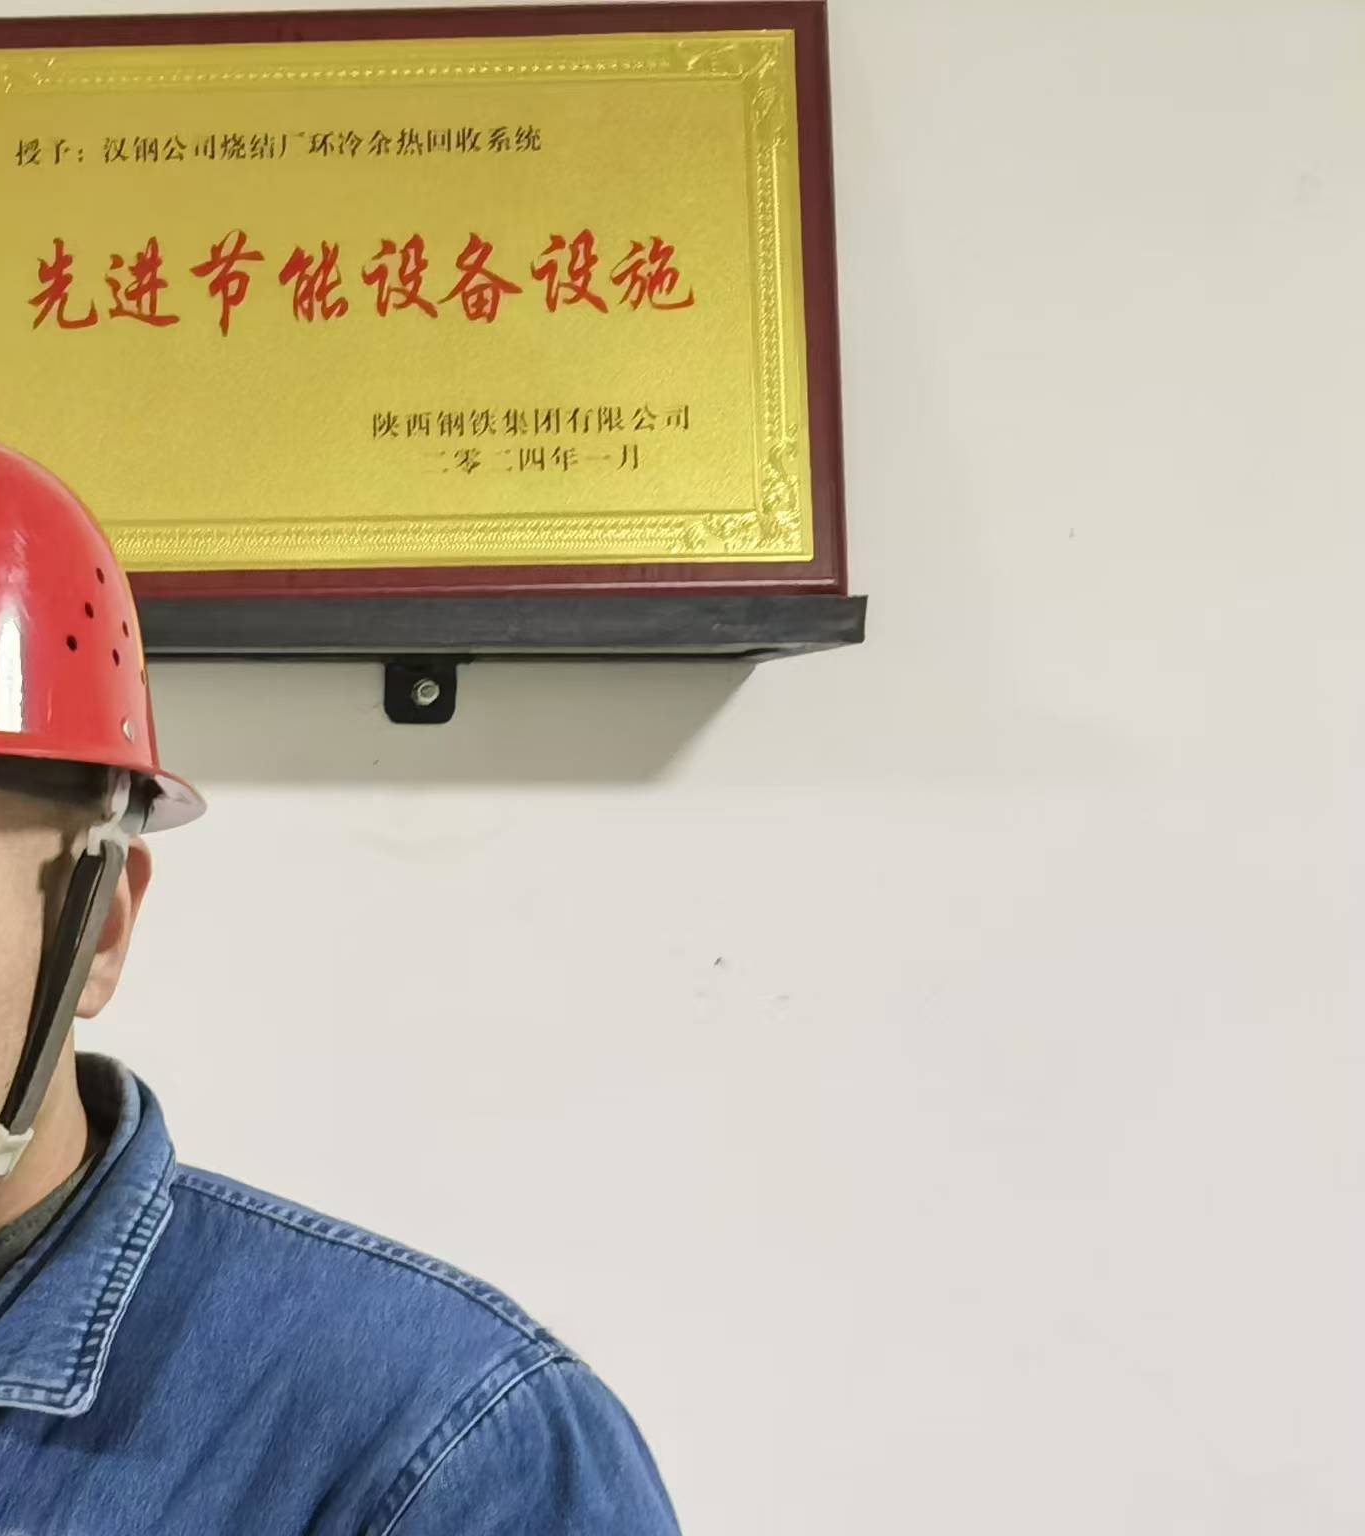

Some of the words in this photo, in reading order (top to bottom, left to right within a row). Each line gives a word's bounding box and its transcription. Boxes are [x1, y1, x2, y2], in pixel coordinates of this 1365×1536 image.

[14, 123, 543, 167] 授予：汉钢公司烧结厂环冷余热回收系统
[27, 227, 695, 338] 先进节能设备设施
[372, 403, 691, 438] 陕西钢铁集团有限公司
[421, 444, 639, 475] 二零二四年一月
